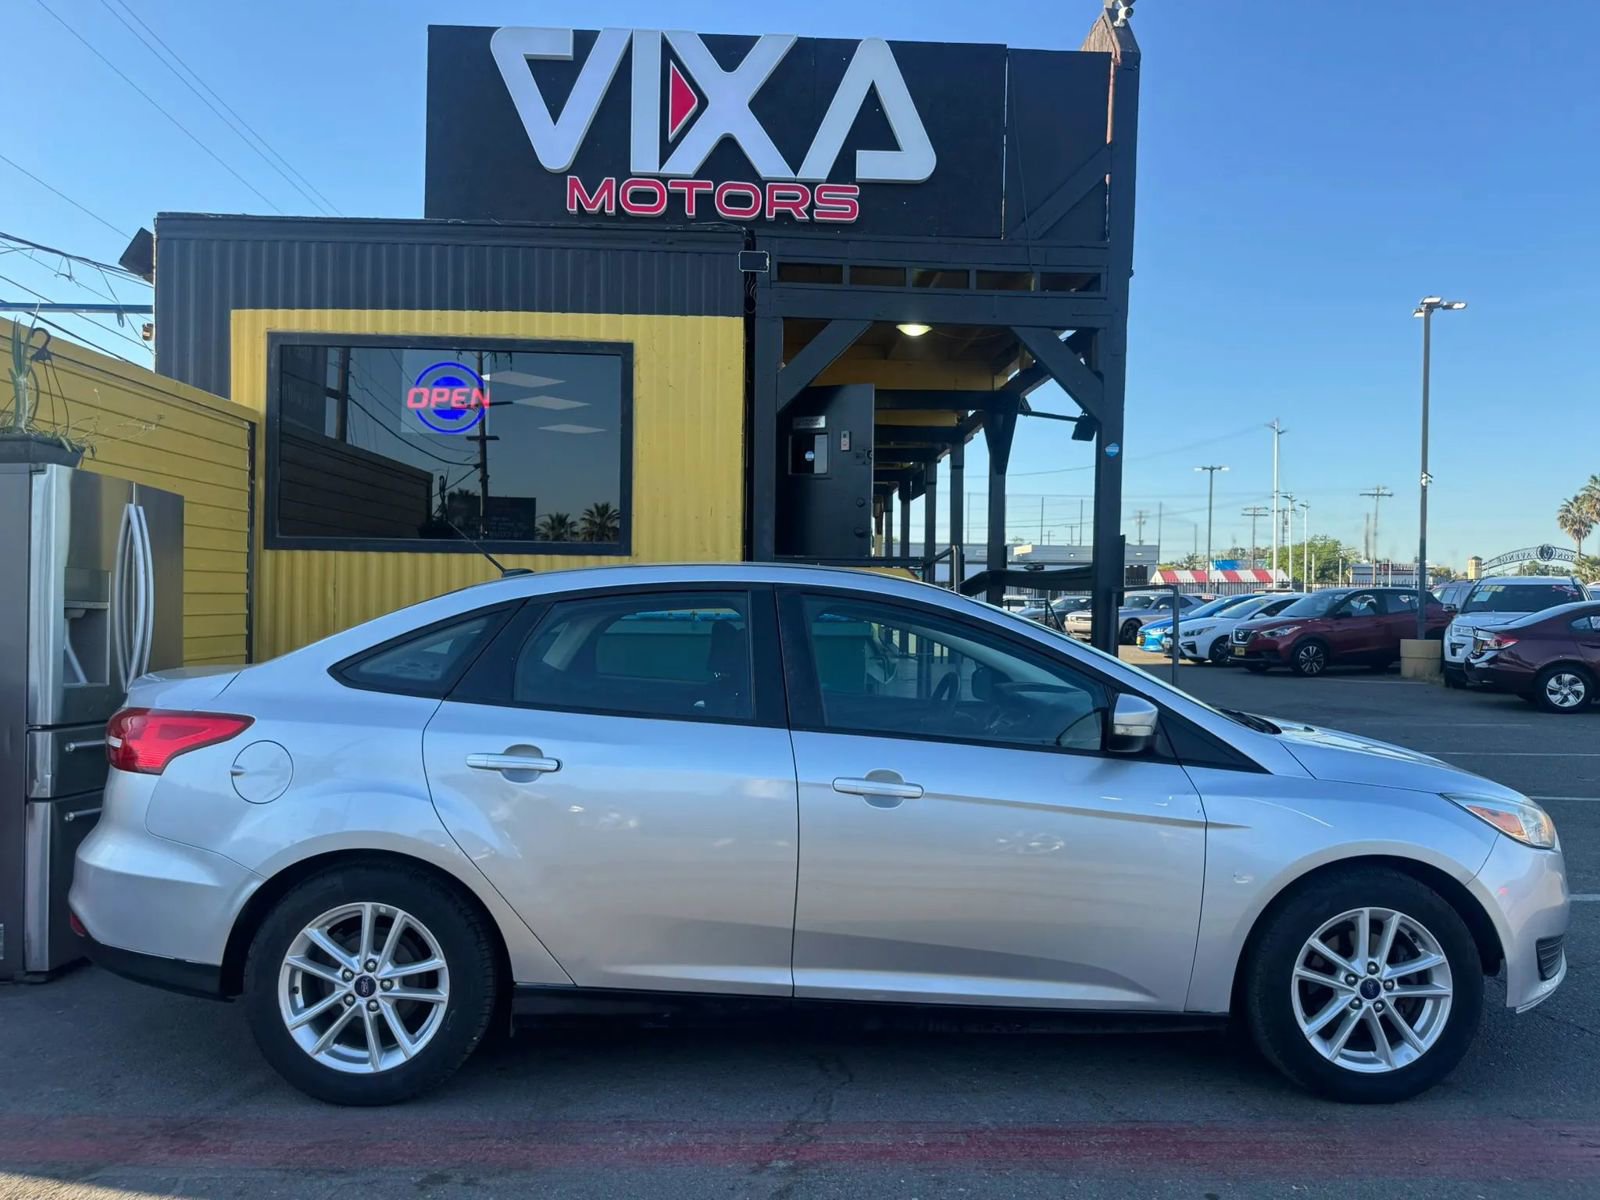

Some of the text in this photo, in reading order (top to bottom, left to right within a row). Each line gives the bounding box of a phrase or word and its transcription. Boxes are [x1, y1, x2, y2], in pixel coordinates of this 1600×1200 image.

[490, 27, 938, 183] VIXA
[565, 176, 861, 223] MOTORS
[407, 387, 490, 409] OPEN
